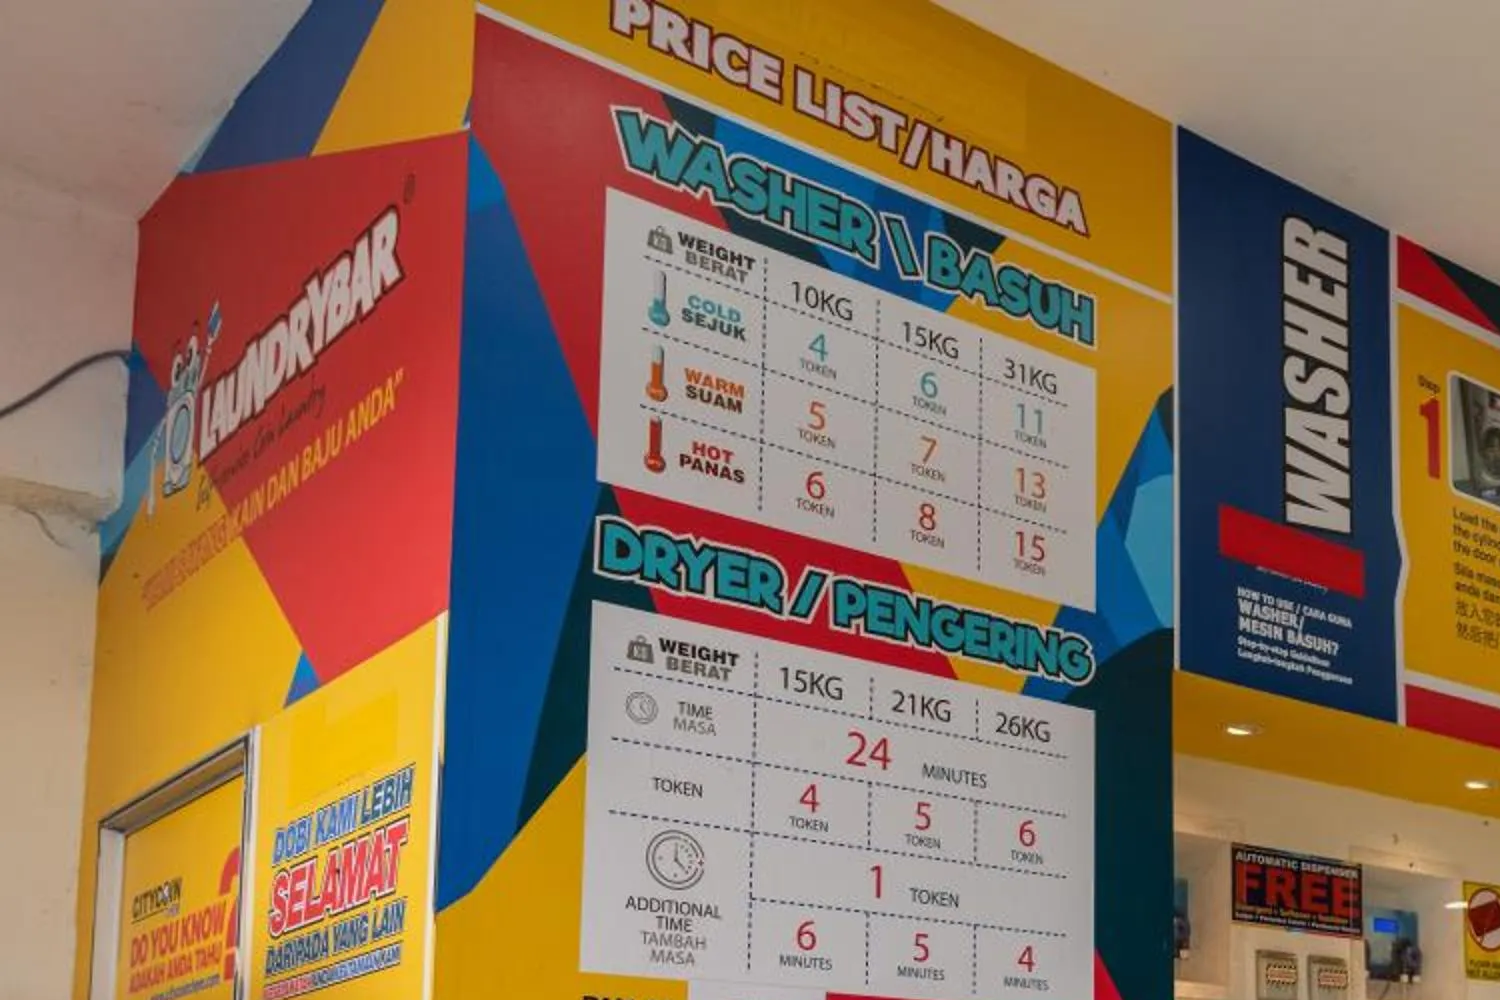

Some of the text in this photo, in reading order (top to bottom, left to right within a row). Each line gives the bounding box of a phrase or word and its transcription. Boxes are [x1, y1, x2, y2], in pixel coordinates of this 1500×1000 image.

[609, 0, 1091, 238] PRICE LIST/HARGA
[609, 106, 1097, 347] WASHER BASUH
[677, 230, 756, 271] WEIGHT
[684, 247, 750, 286] BERAT
[681, 309, 746, 343] SEJUK
[687, 294, 743, 323] COLD
[200, 204, 404, 463] LAUNDRYBAR
[790, 281, 1058, 395] 10KG 15KG 31KG
[684, 366, 745, 399] WARM
[684, 384, 744, 415] SUAM
[808, 334, 1045, 434] 4 6 11
[1282, 216, 1352, 535] WASHER
[800, 355, 1047, 450] TOKEN TOKEN TOKEN
[690, 440, 735, 465] HOT
[808, 401, 1046, 499] 5 7 13
[1420, 398, 1440, 480] 1
[267, 461, 299, 510] DAN
[301, 424, 343, 482] BAJU
[679, 453, 746, 485] PANAS
[798, 427, 1047, 514] TOKEN TOKEN TOKEN
[796, 496, 1046, 577] TOKEN TOKEN TOKEN
[805, 470, 1046, 561] 6 8 15
[593, 515, 1096, 686] DRYER PENGERING
[1238, 586, 1260, 600] HOW
[659, 637, 740, 668] WEIGHT
[1238, 614, 1340, 656] MESIN BASUH?
[665, 655, 732, 683] BERAT
[672, 715, 718, 737] MASA
[677, 700, 713, 721] TIME
[779, 666, 1052, 744] 15KG 21KG 26KG
[845, 731, 988, 789] 24 MINUTES
[315, 795, 358, 845] KAMI
[359, 765, 415, 824] LEBIH
[651, 776, 704, 799] TOKEN
[798, 783, 1036, 848] 4 5 6
[790, 815, 1044, 866] TOKEN TOKEN TOKEN
[1236, 851, 1299, 872] AUTOMATIC
[267, 817, 411, 938] SELAMAT
[869, 865, 960, 909] 1 TOKEN
[1236, 862, 1360, 918] FREE
[371, 896, 406, 942] LAIN
[625, 895, 722, 921] ADDITIONAL
[656, 914, 693, 934] TIME
[130, 901, 226, 969] DO YOU KNOW
[640, 930, 707, 952] TAMBAH
[650, 948, 696, 968] MASA
[796, 920, 1036, 974] 6 5 4
[778, 951, 1048, 993] MINUTES MINUTES MINUTES
